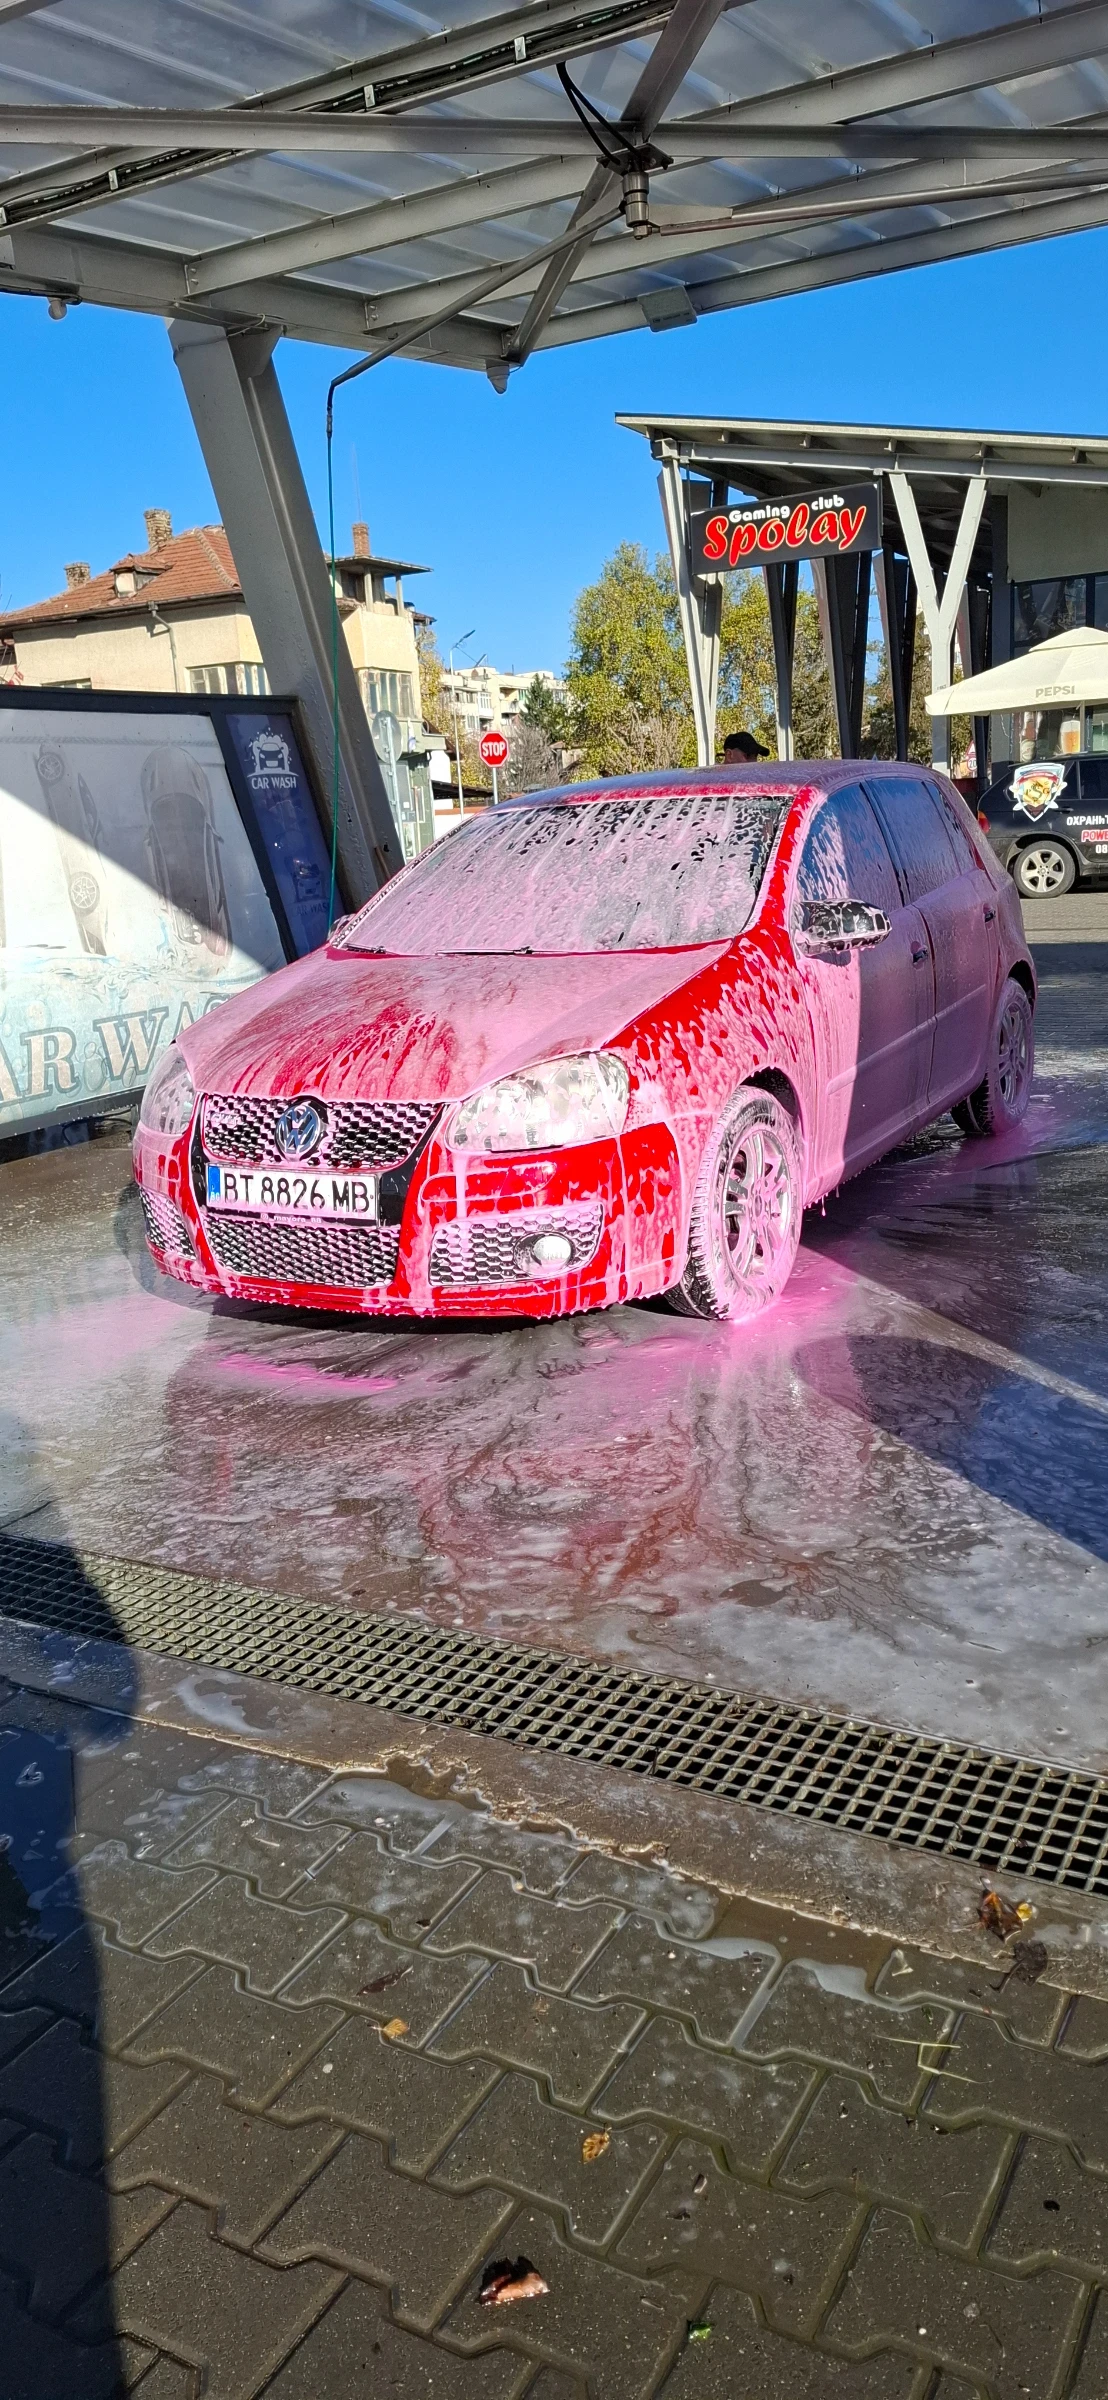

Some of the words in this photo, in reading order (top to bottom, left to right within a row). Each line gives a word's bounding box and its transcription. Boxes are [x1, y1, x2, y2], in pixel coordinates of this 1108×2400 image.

[728, 504, 791, 523] Gaming
[811, 494, 845, 511] club
[702, 502, 867, 567] Spolay
[1035, 685, 1076, 698] PEPSI
[481, 741, 506, 757] STOP
[251, 777, 270, 790] CAR
[270, 776, 297, 789] WASH
[224, 1173, 254, 1204] BT
[260, 1176, 326, 1210] 8826
[332, 1179, 370, 1213] MB
